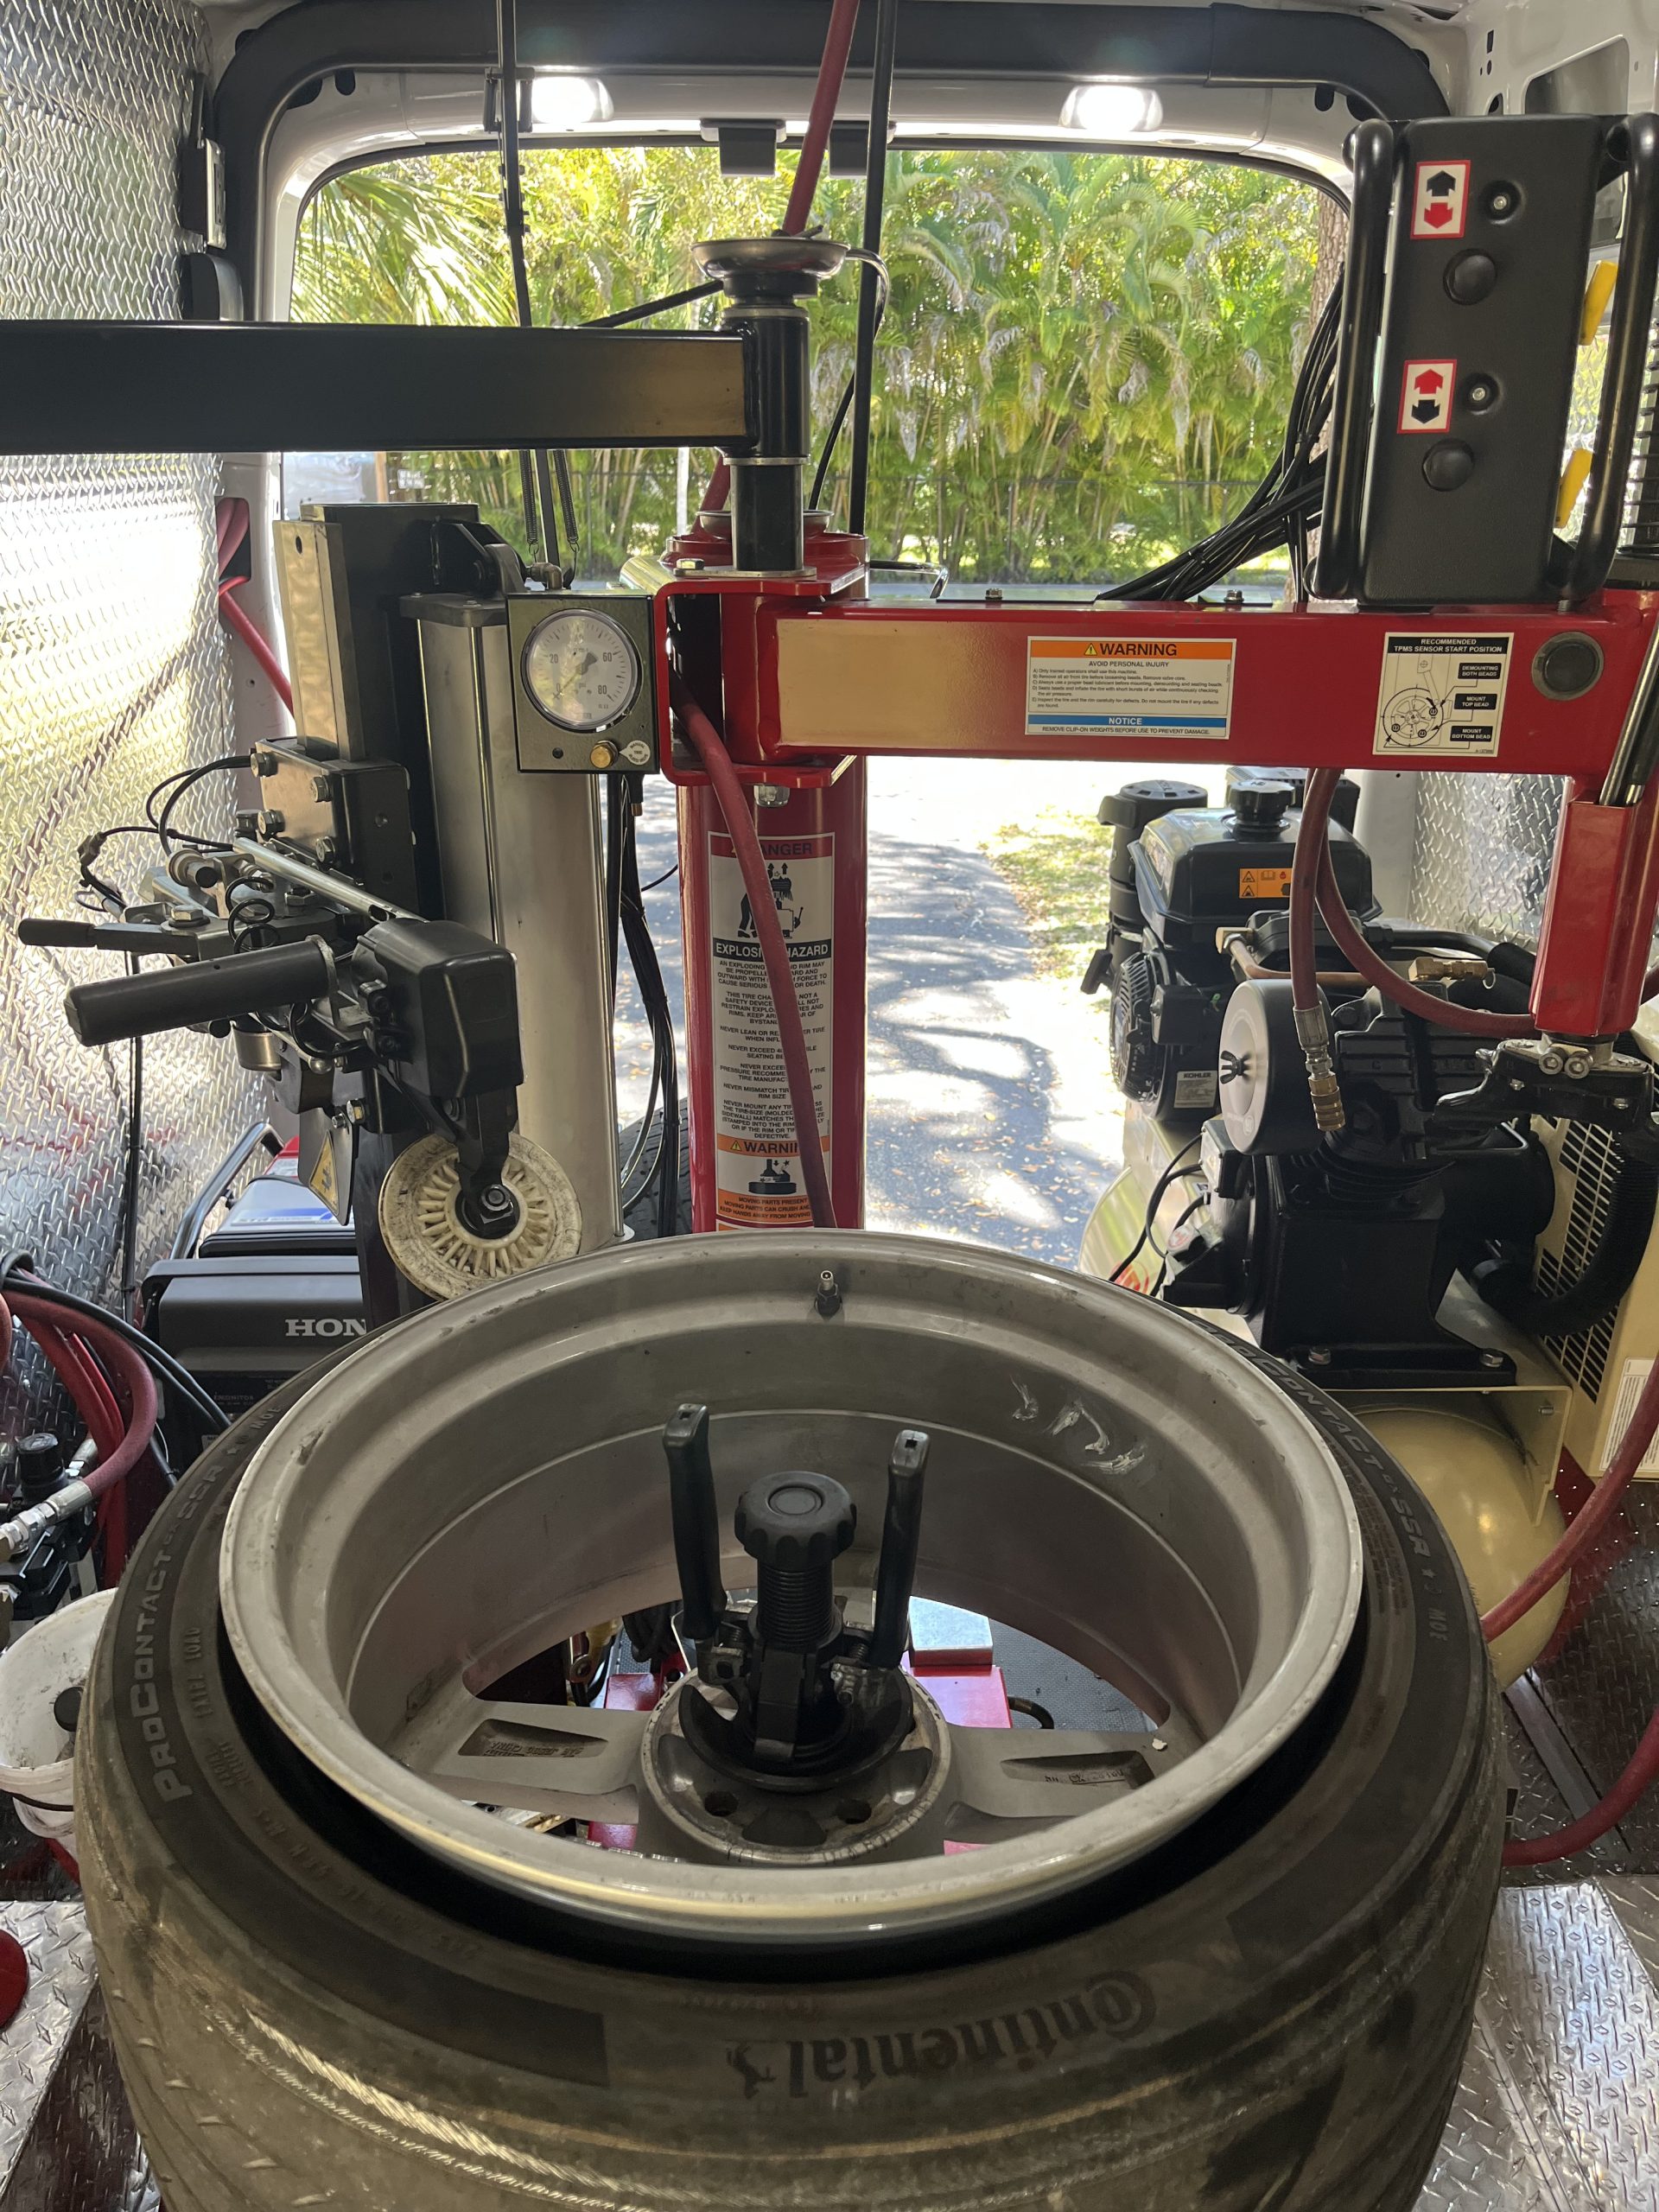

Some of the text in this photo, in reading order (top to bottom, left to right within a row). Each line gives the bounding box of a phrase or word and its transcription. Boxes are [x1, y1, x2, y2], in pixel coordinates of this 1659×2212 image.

[1100, 643, 1177, 656] WARNING
[550, 654, 558, 664] 20
[603, 652, 612, 662] 60
[598, 685, 607, 694] 80
[761, 842, 813, 855] ANGER
[716, 943, 761, 957] EXPLOSI
[717, 972, 747, 981] OUTWARD
[721, 1002, 750, 1011] RESTRAIN
[720, 1065, 750, 1075] PRESSURE
[721, 1110, 752, 1121] SIDEWALL)
[735, 1107, 764, 1116] TIRE-SIZE
[722, 1116, 750, 1126] (STAMPED
[744, 1141, 798, 1154] WARNI
[724, 1200, 744, 1209] MOVING
[285, 1318, 366, 1338] HON
[176, 1465, 226, 1521] SSR
[250, 1407, 283, 1429] MOE
[1389, 1497, 1433, 1558] SSR
[1427, 1605, 1450, 1642] MOE
[788, 1967, 1160, 2099] Continental
